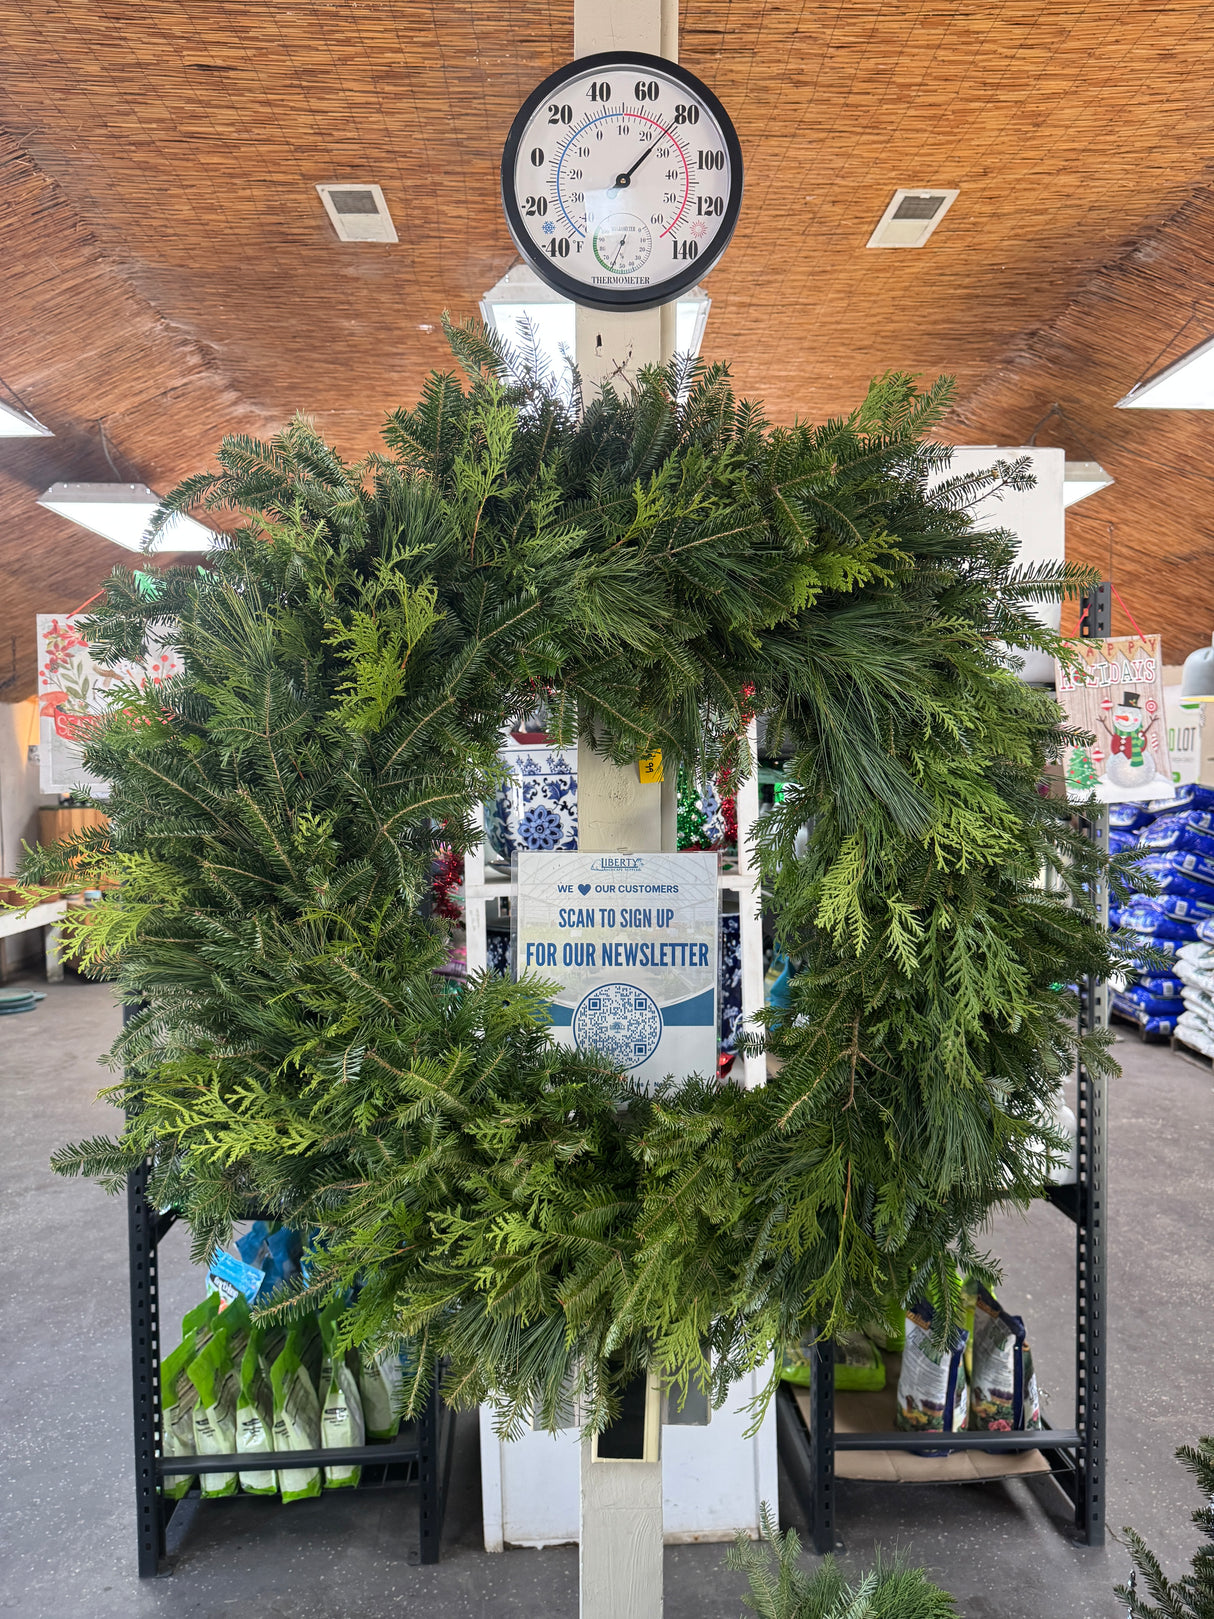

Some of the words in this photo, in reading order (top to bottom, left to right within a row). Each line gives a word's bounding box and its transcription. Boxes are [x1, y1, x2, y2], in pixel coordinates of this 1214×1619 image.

[586, 81, 611, 102] 40
[634, 81, 659, 101] 60
[548, 104, 573, 125] 20
[675, 104, 700, 125] 80
[596, 131, 603, 141] 0
[617, 125, 630, 135] 10
[639, 131, 652, 142] 20
[530, 148, 545, 167] 0
[574, 147, 590, 158] -10
[656, 148, 670, 158] 30
[697, 150, 725, 170] 100
[566, 169, 583, 180] -20
[665, 169, 678, 180] 40
[569, 192, 585, 203] -30
[663, 192, 676, 203] 50
[521, 196, 548, 217] -20
[696, 196, 724, 217] 120
[650, 213, 664, 225] 60
[541, 237, 570, 258] -40
[672, 239, 698, 260] 140
[591, 276, 650, 285] THERMOMETER
[601, 857, 638, 868] LIBERTY
[557, 884, 574, 893] WE
[595, 884, 616, 893] OUR
[618, 884, 679, 893] CUSTOMERS
[558, 908, 595, 928] SCAN
[599, 908, 616, 928] TO
[620, 908, 652, 928] SIGN
[656, 908, 674, 928] UP
[526, 942, 557, 967] FOR
[563, 942, 596, 967] OUR
[601, 942, 709, 967] NEWSLETTER
